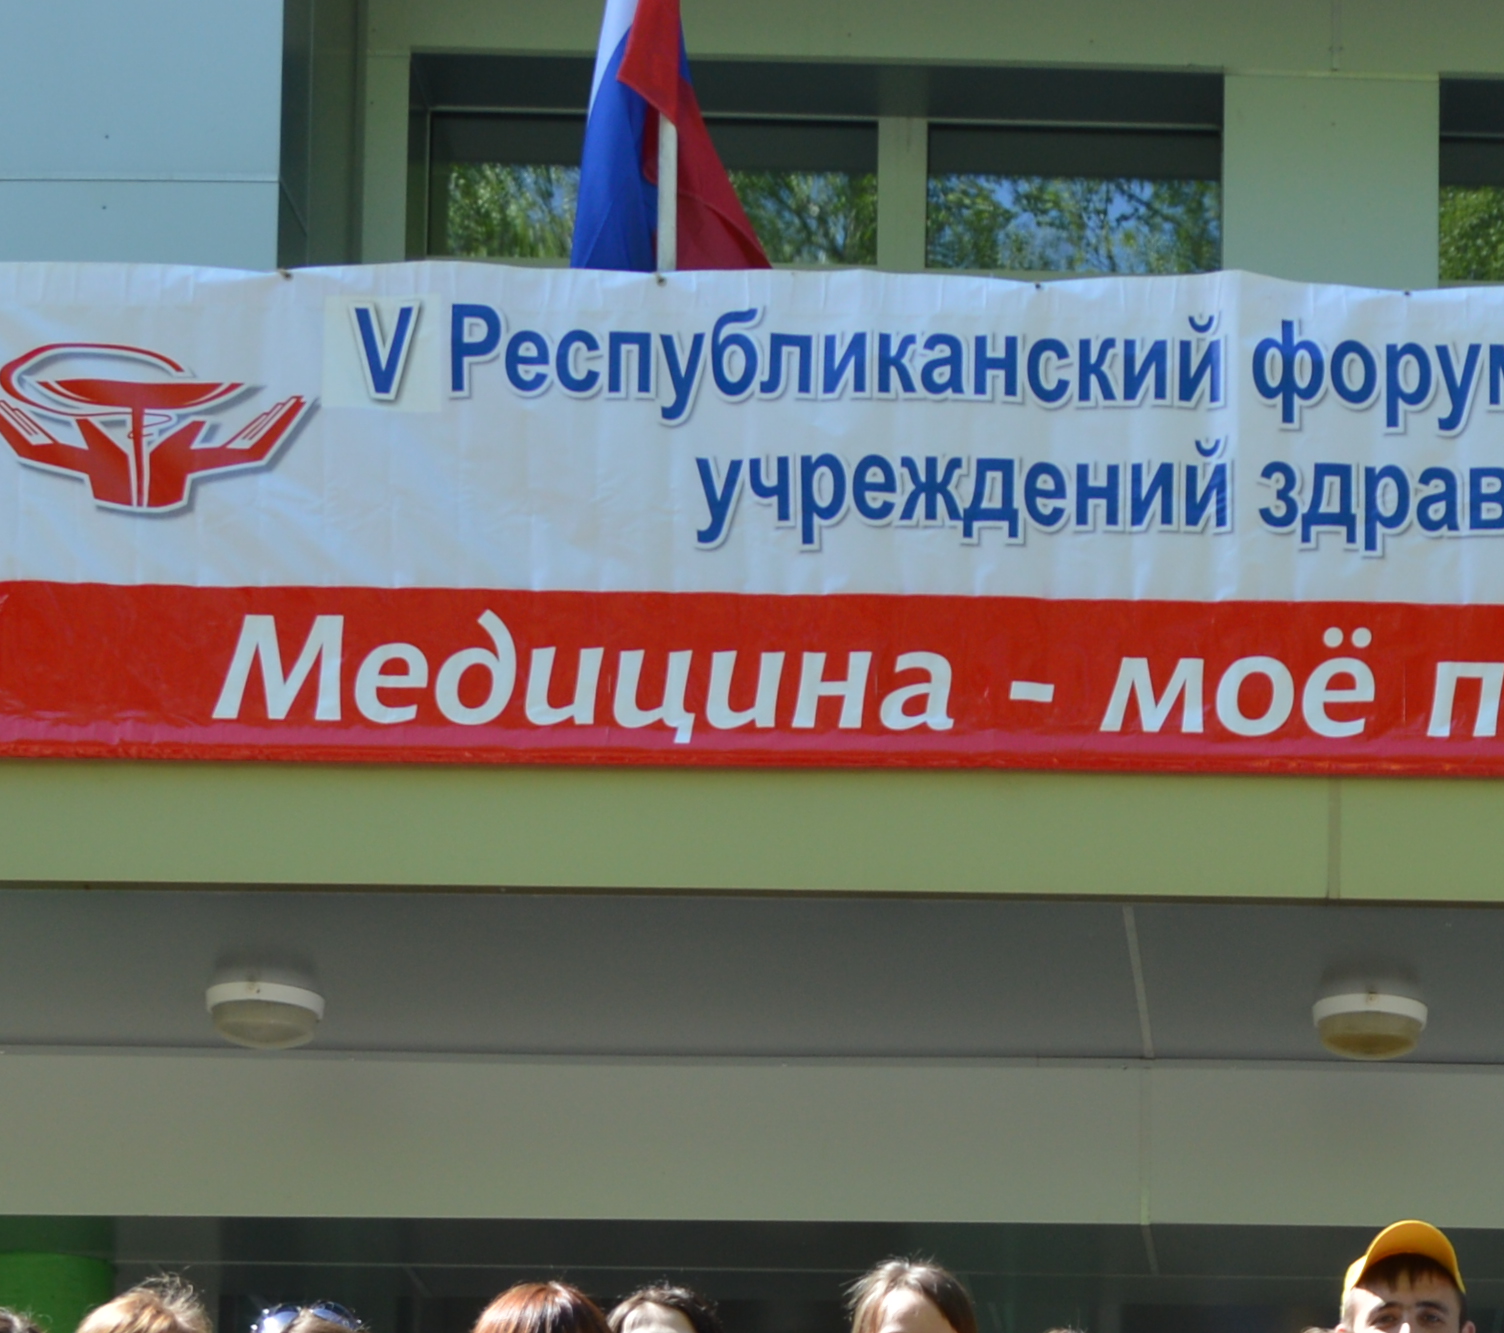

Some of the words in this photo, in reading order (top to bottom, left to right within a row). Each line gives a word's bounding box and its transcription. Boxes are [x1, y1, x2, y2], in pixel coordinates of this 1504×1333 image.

[353, 304, 416, 396] V
[448, 302, 1223, 422] Республиканский
[695, 438, 1229, 546] учреждений
[211, 608, 956, 745] Медицина
[1098, 626, 1376, 739] моё
